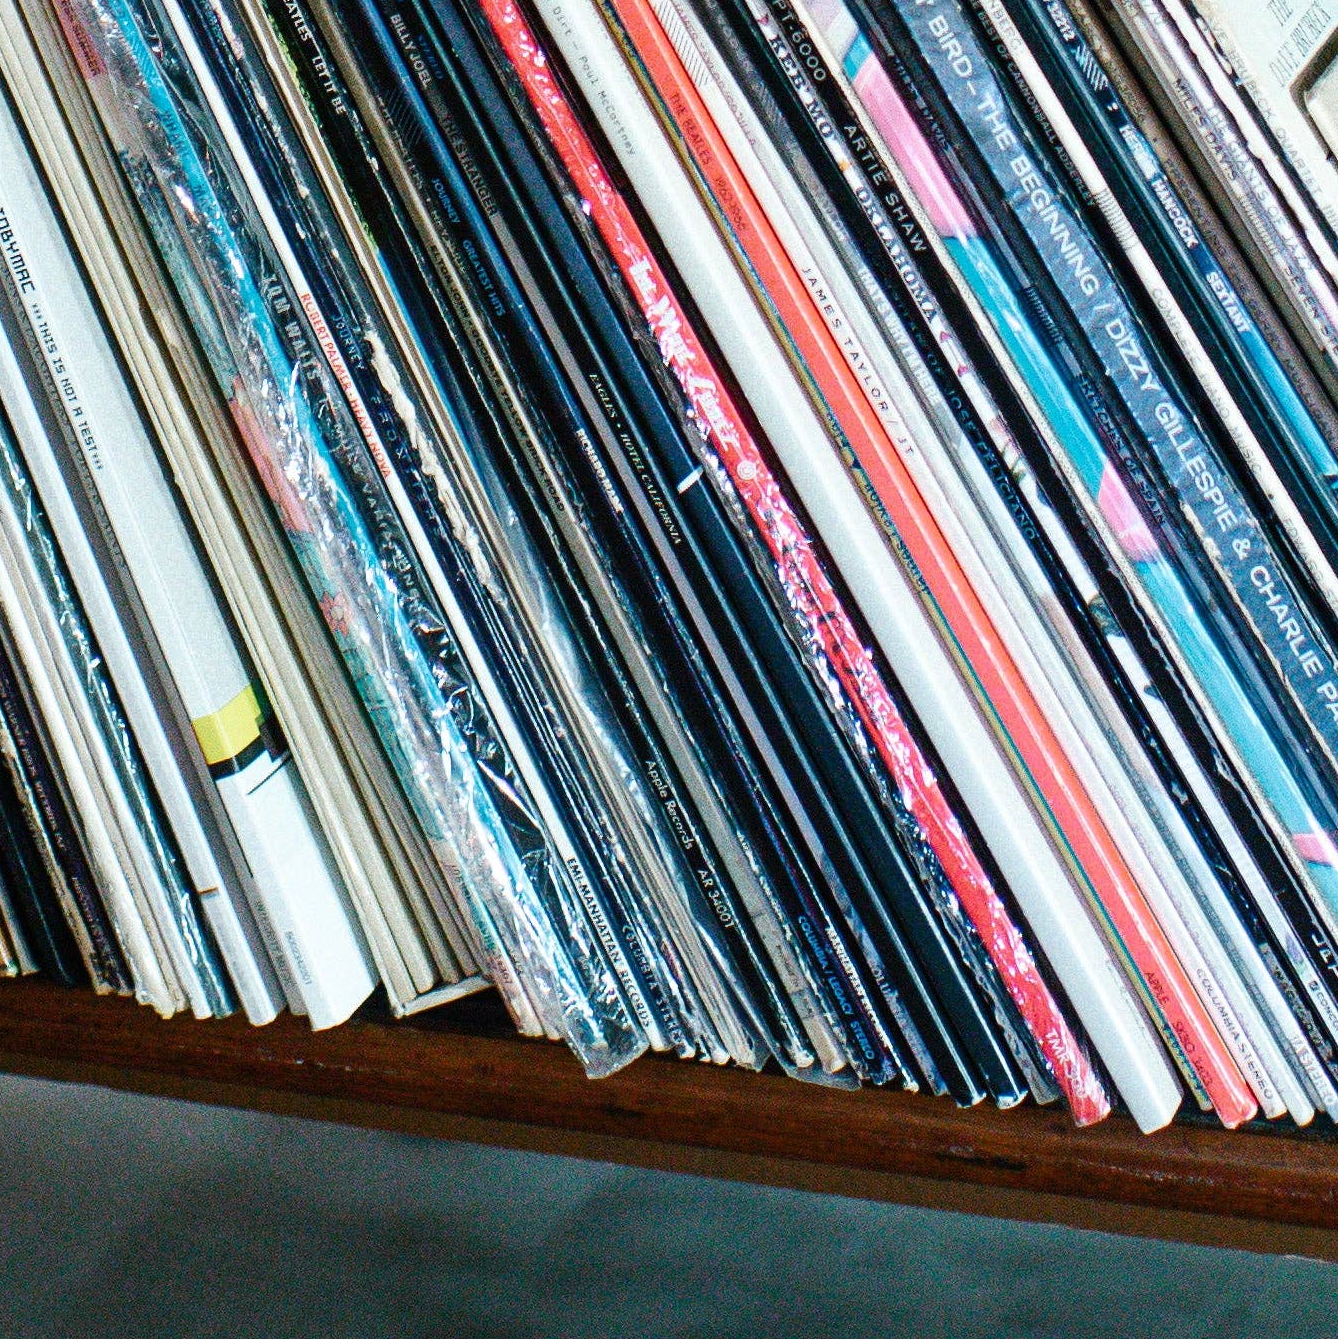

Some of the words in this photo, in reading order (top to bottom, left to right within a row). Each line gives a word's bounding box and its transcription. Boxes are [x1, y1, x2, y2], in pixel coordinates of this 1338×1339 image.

[310, 54, 331, 80] LET
[322, 79, 338, 96] IT
[330, 96, 347, 115] BE
[389, 12, 416, 52] BILLY
[408, 50, 434, 87] JOEL
[454, 141, 499, 216] STRANGER
[551, 6, 574, 37] Dirt
[576, 54, 600, 86] Paul
[595, 89, 638, 157] McCartney
[681, 118, 713, 165] BEATLES
[976, 10, 998, 38] BEST
[995, 42, 1010, 60] OF
[1005, 61, 1059, 145] CANNONBALL
[1053, 143, 1095, 208] ADDERLEY
[1170, 77, 1207, 129] MILES
[1202, 131, 1239, 183] DAVIS
[431, 177, 460, 225] JOURNEY
[461, 238, 493, 291] GREATEST
[487, 290, 506, 316] HITS
[843, 122, 887, 186] ARTIE
[883, 191, 926, 254] SHAW
[854, 185, 939, 323] OKLAHOMA
[1151, 178, 1199, 248] HANCOCK
[1206, 270, 1250, 333] SEXTANT
[450, 285, 470, 318] JOHN
[801, 265, 842, 328] JAMES
[842, 337, 889, 411] TAYLOR
[897, 433, 914, 455] JT
[926, 13, 975, 80] BIRD
[976, 97, 1016, 151] THE
[1009, 154, 1101, 296] BEGINNING
[1103, 317, 1159, 396] DIZZY
[1152, 399, 1238, 531] GILLESPIE
[1230, 533, 1254, 559] &
[1247, 563, 1324, 678] CHARLIE
[51, 357, 66, 374] IS
[60, 377, 78, 403] NOT
[71, 405, 84, 417] A
[299, 292, 331, 342] ROBERT
[322, 341, 354, 391] PALMER
[349, 398, 376, 439] HEAVY
[369, 441, 393, 478] NOVA
[575, 427, 607, 479] RICHARD
[588, 372, 618, 418] EAGLES
[619, 431, 646, 473] HOTEL
[640, 472, 683, 545] CALIFORNIA
[642, 758, 670, 798] Apple
[663, 798, 696, 850] Records
[697, 867, 714, 888] AR
[707, 888, 734, 929] 34001
[619, 968, 654, 1027] RECORDS
[796, 914, 830, 968] COLUMBIA
[827, 975, 854, 1016] LEGACY
[849, 1019, 876, 1060] STEREO
[1195, 966, 1242, 1042] COLUMBIA
[1236, 1041, 1274, 1100] STEREO
